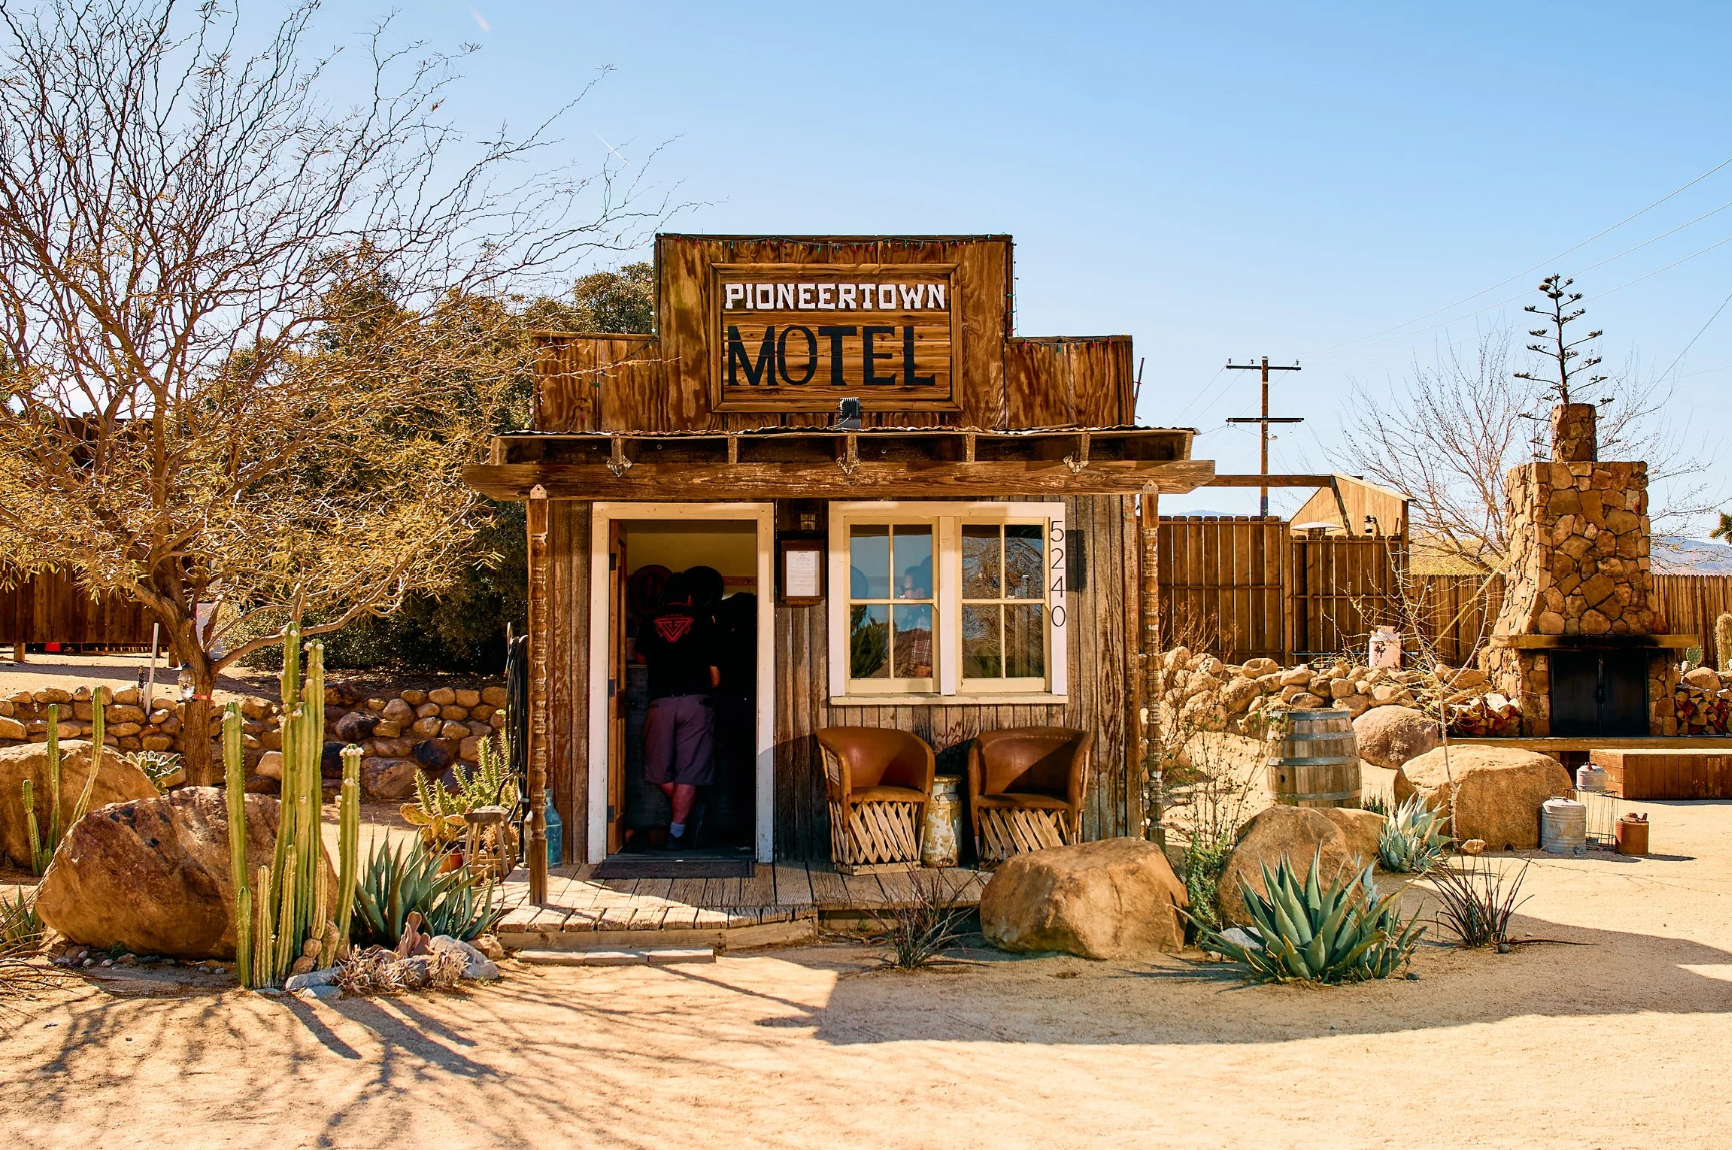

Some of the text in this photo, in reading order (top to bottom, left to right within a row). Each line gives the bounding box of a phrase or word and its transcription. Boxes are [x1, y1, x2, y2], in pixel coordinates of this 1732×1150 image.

[725, 283, 945, 309] PIONEERTOWN
[727, 325, 936, 386] MOTEL
[1050, 520, 1066, 627] 5240
